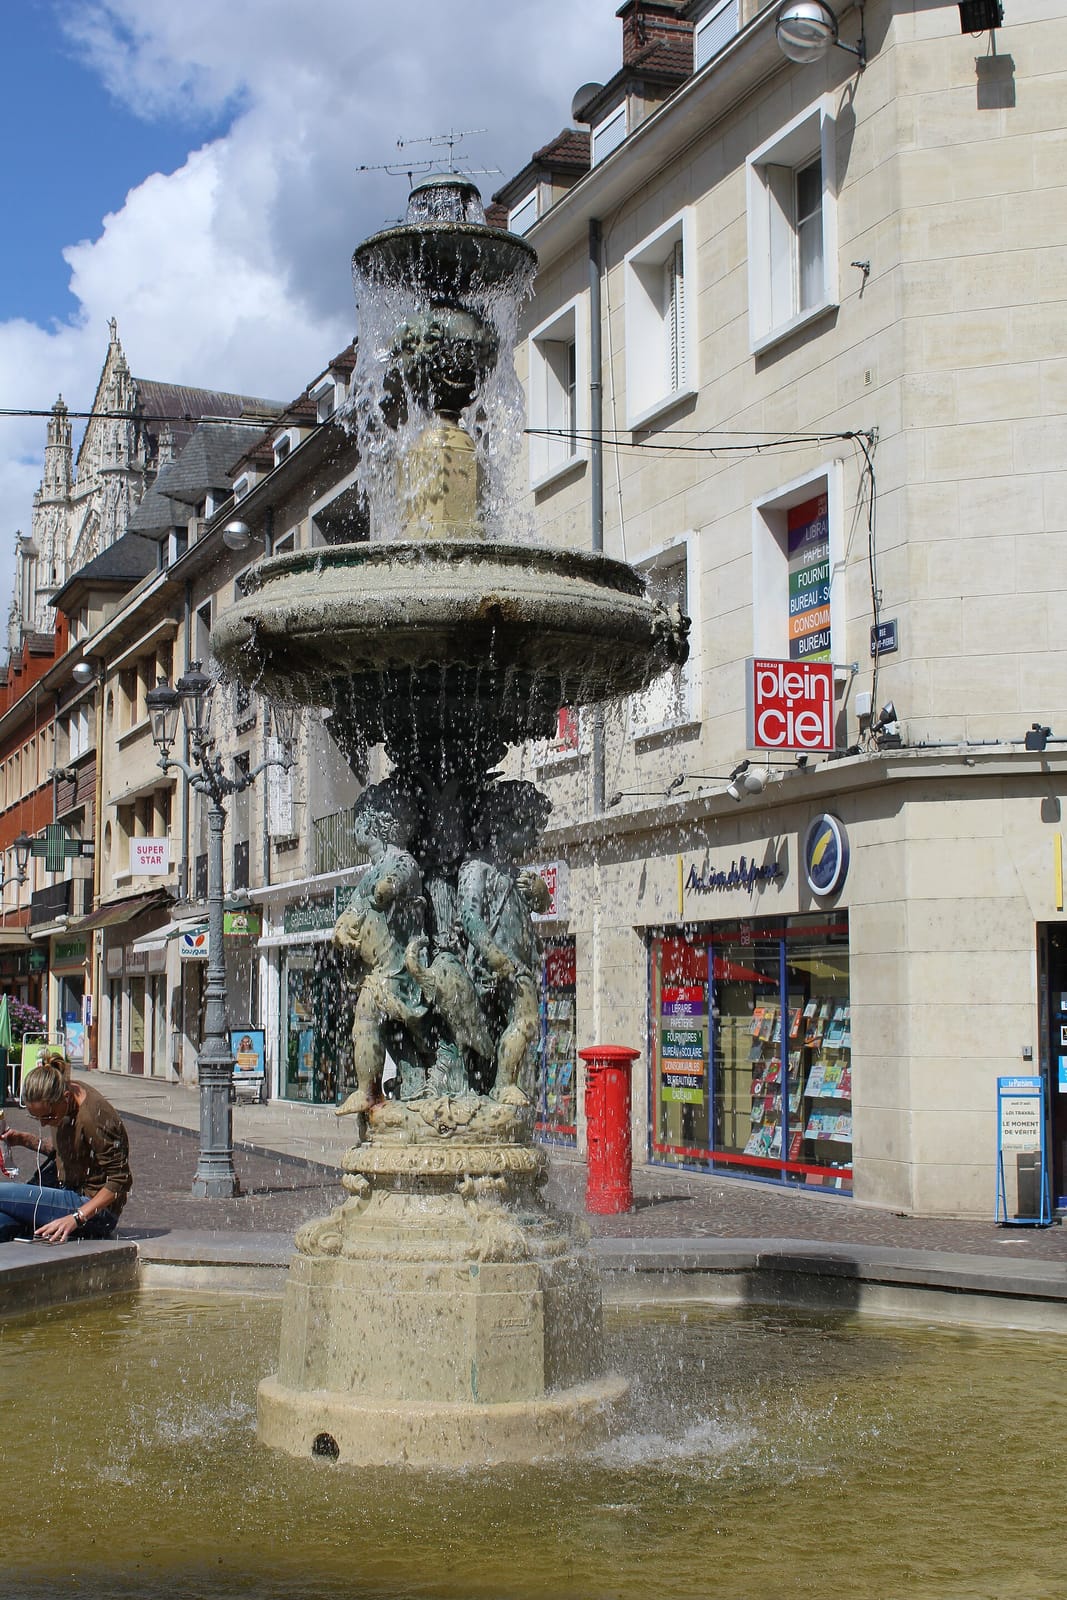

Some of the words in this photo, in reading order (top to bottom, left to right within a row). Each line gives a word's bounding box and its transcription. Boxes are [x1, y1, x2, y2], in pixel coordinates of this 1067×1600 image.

[790, 590, 818, 613] BUREAU
[757, 664, 830, 704] plein
[757, 699, 831, 747] ciel
[136, 845, 164, 854] SUPER
[140, 856, 162, 864] STAR
